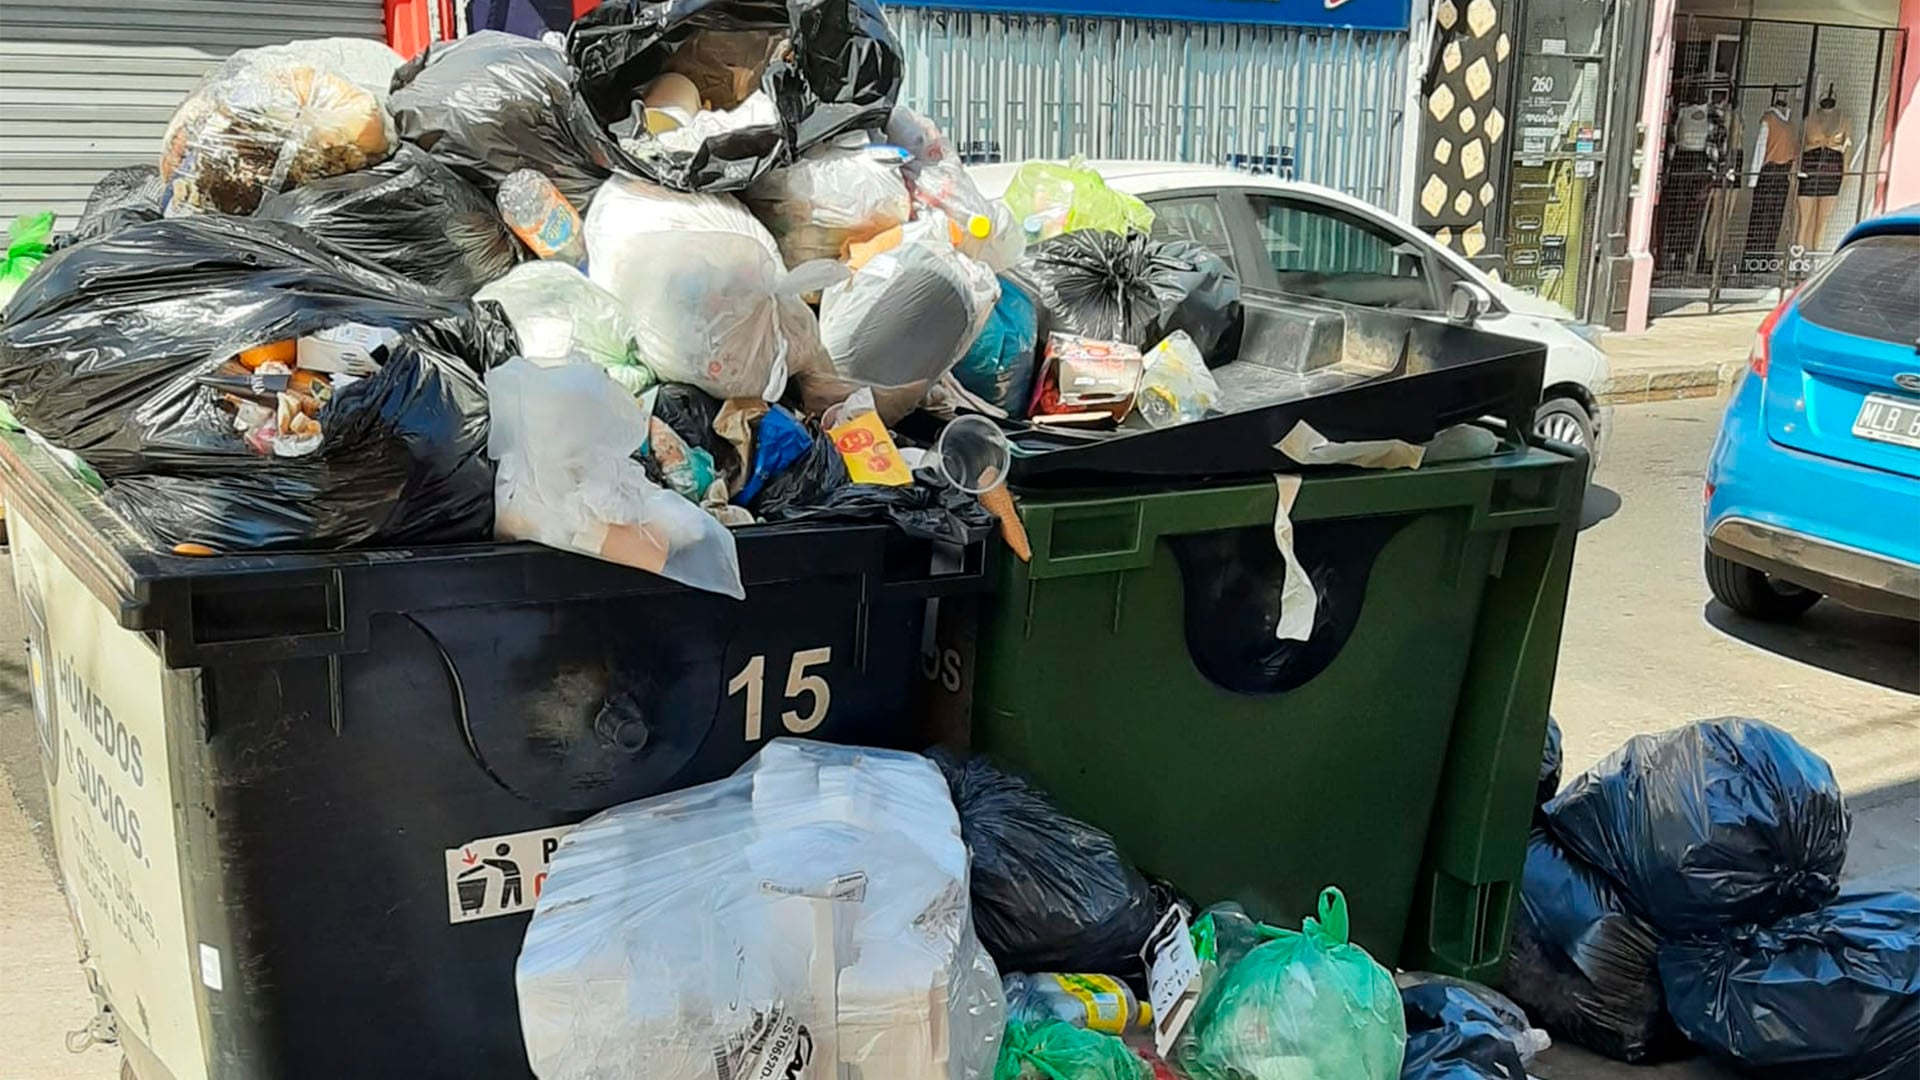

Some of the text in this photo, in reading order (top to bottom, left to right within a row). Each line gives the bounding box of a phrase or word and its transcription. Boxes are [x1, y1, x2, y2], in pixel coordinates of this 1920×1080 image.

[1531, 76, 1553, 93] 260
[957, 141, 1001, 153] LIREIA
[58, 650, 144, 787] HÚMEDOS
[728, 646, 832, 742] 15
[76, 746, 151, 869] SUCIOS.
